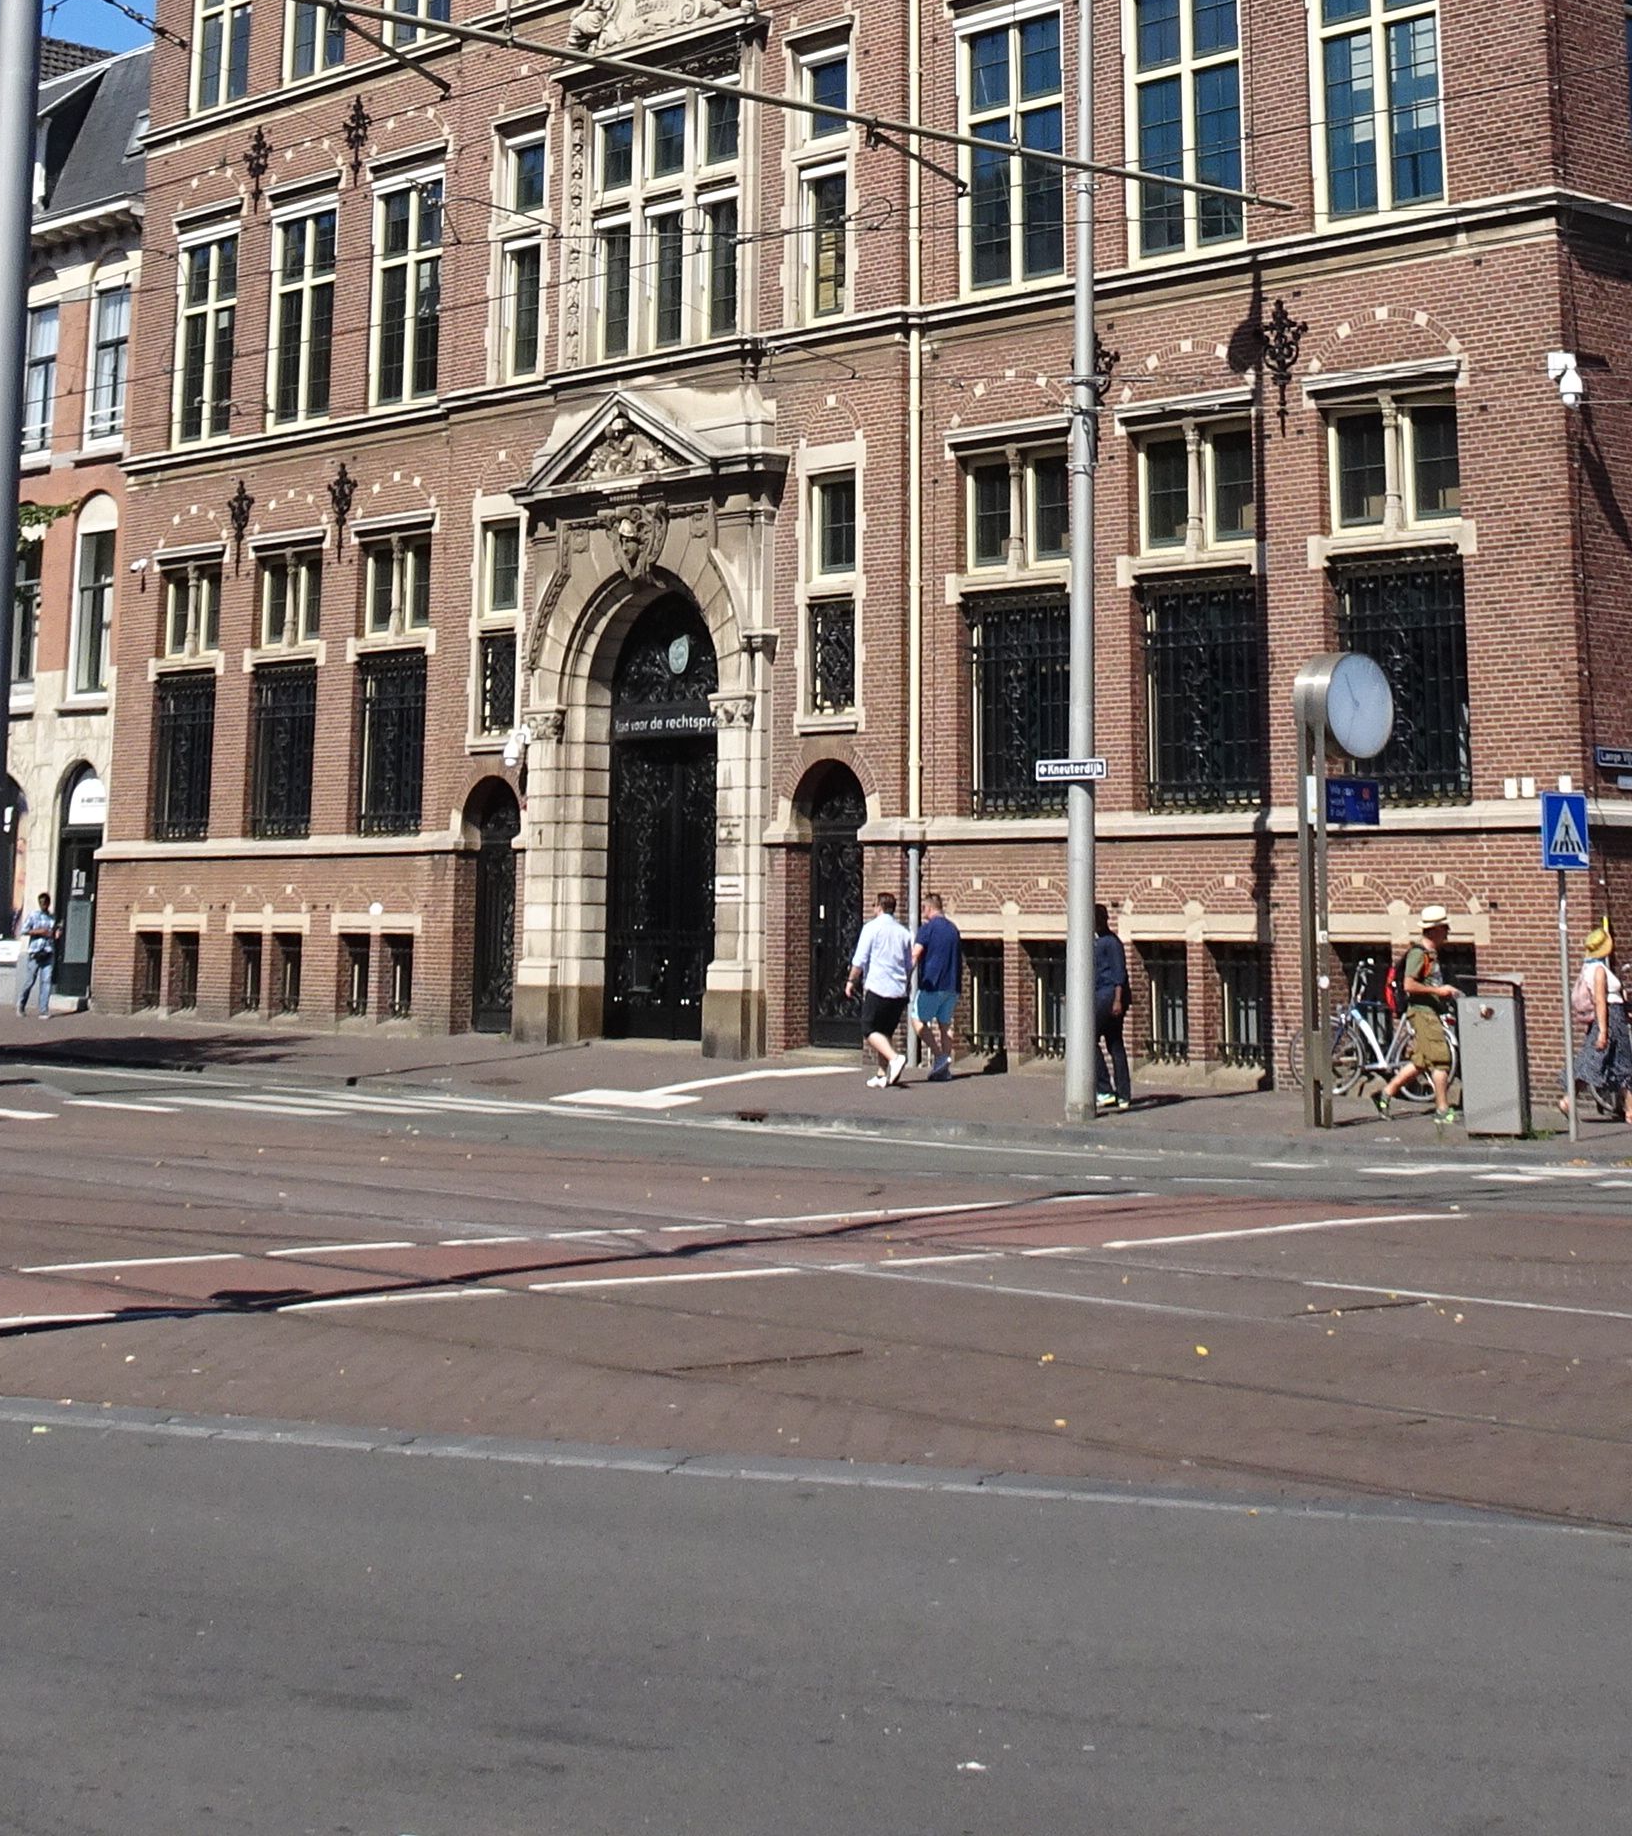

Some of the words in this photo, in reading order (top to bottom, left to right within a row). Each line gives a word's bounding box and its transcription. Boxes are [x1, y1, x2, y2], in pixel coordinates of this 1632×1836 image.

[631, 720, 648, 731] voor
[650, 716, 663, 730] de
[1600, 751, 1622, 765] Lange
[1048, 762, 1103, 776] Kneuterdijk
[537, 828, 544, 846] 1
